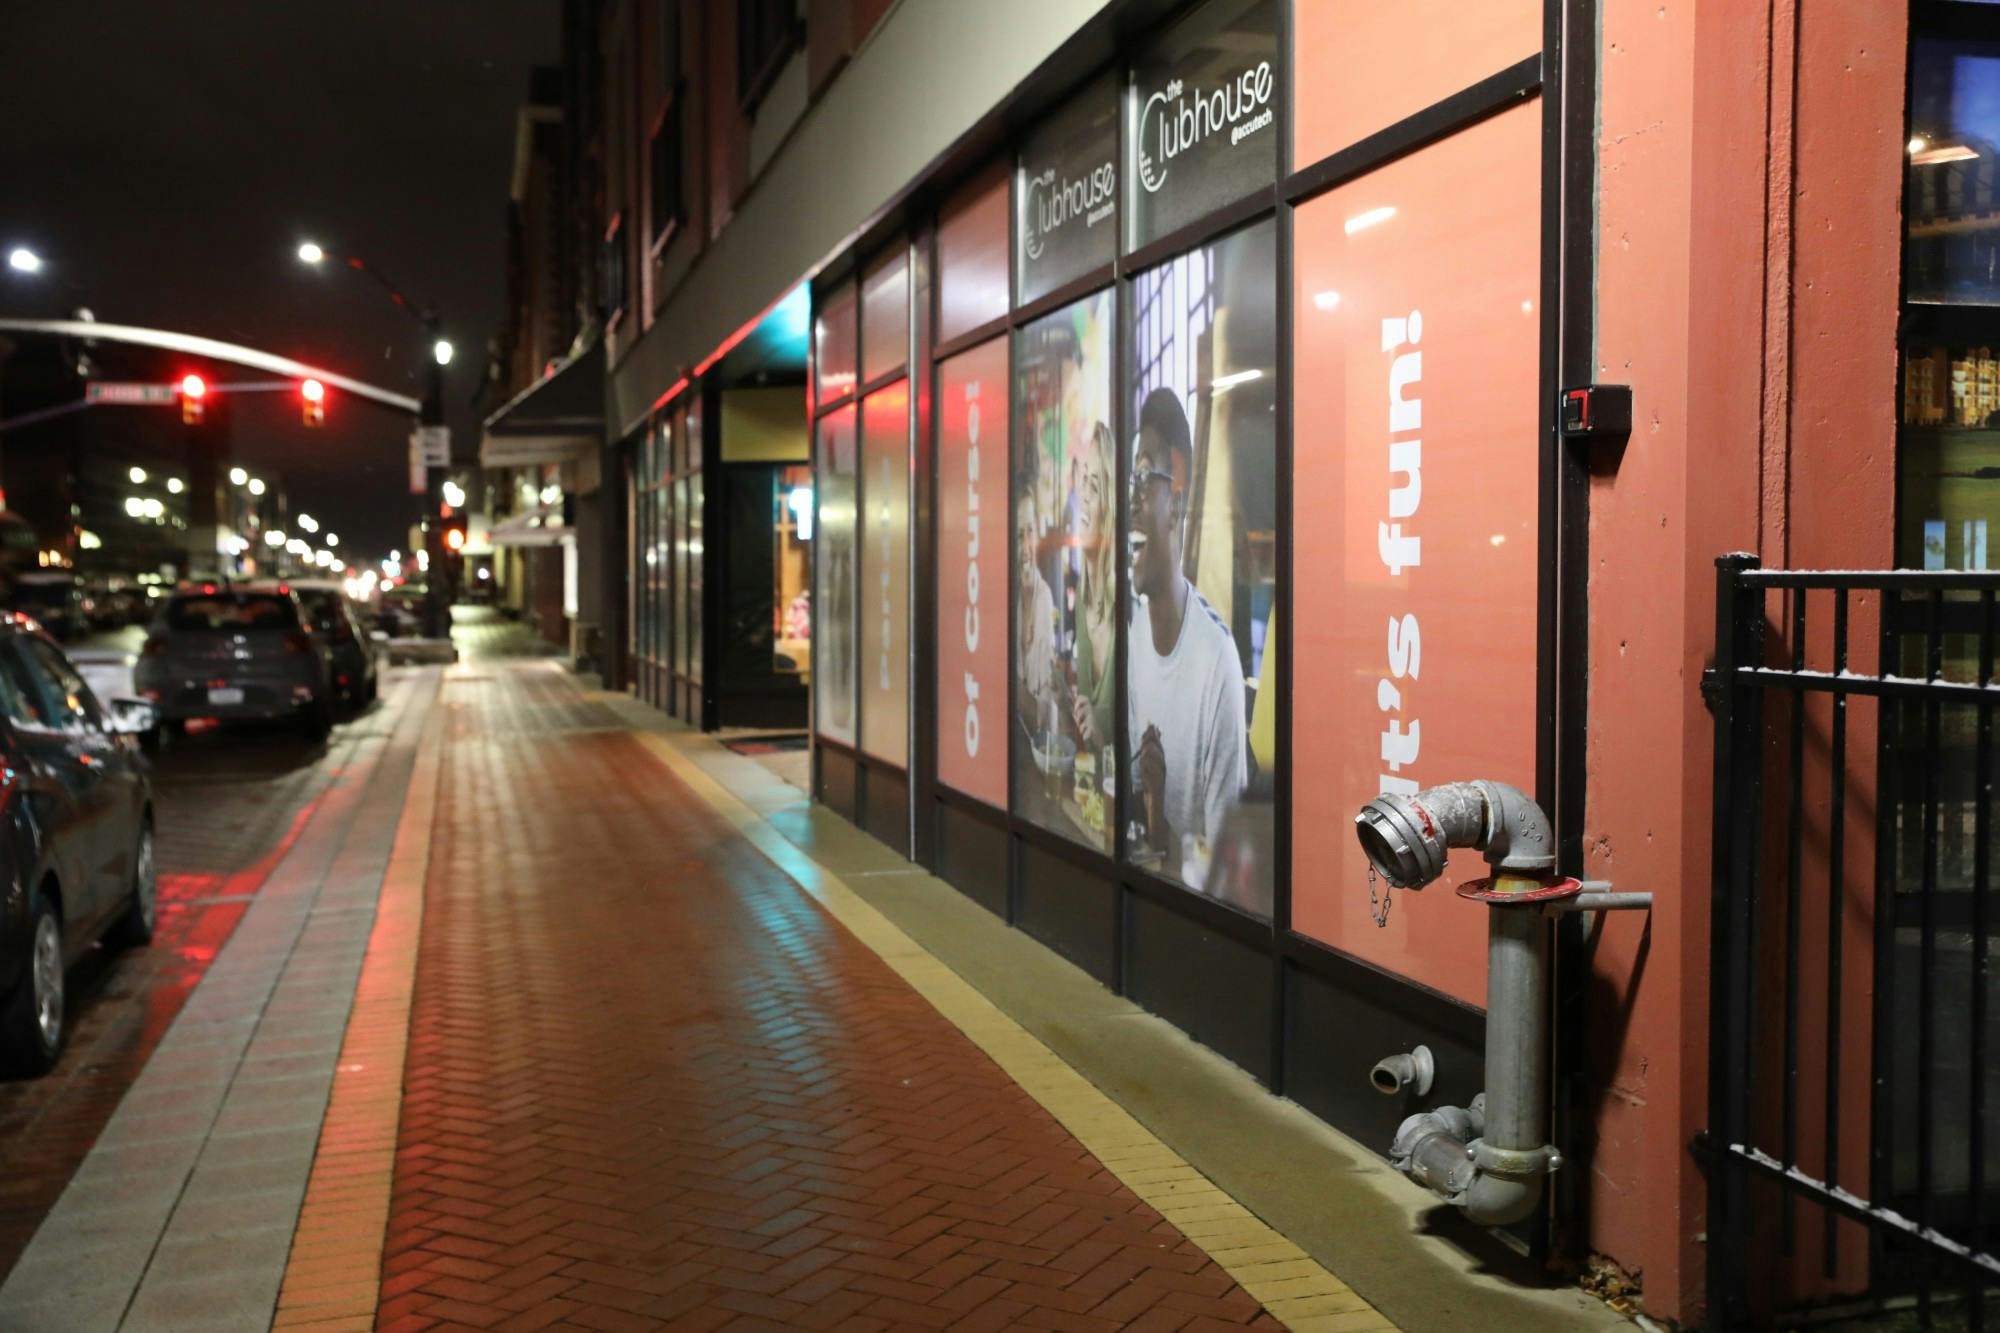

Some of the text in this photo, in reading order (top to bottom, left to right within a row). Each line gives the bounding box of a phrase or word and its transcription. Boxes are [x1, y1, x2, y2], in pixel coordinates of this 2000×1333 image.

[1138, 61, 1273, 193] Clubhouse
[1167, 79, 1183, 102] the
[1231, 107, 1273, 146] @accutech
[1025, 162, 1115, 260] Clubhouse
[1378, 309, 1423, 576] fun!
[965, 671, 980, 758] Of
